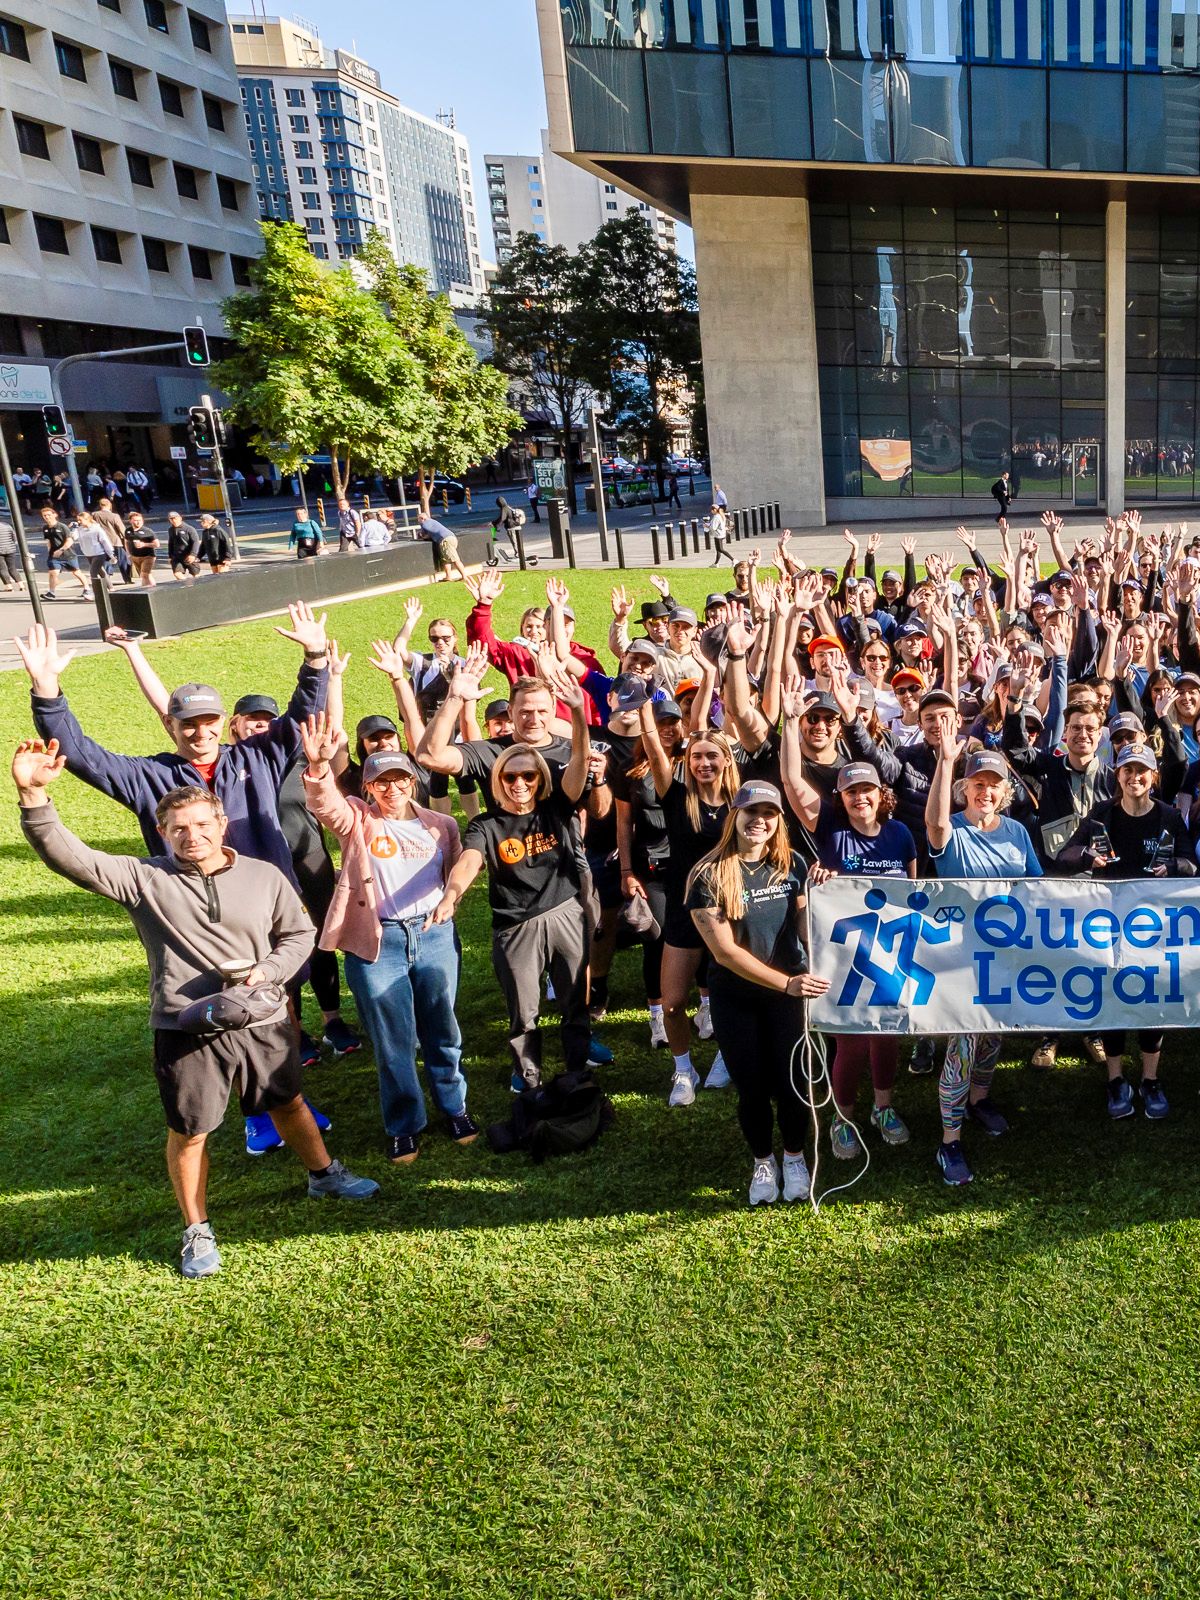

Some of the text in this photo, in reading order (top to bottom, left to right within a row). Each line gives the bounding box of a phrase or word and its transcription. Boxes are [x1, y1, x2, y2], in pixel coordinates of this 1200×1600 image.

[354, 61, 377, 82] SHINE
[537, 469, 552, 477] SET
[538, 477, 553, 488] GO
[861, 858, 904, 869] LawRight
[751, 883, 793, 898] LawRight
[972, 950, 1185, 1021] Legal
